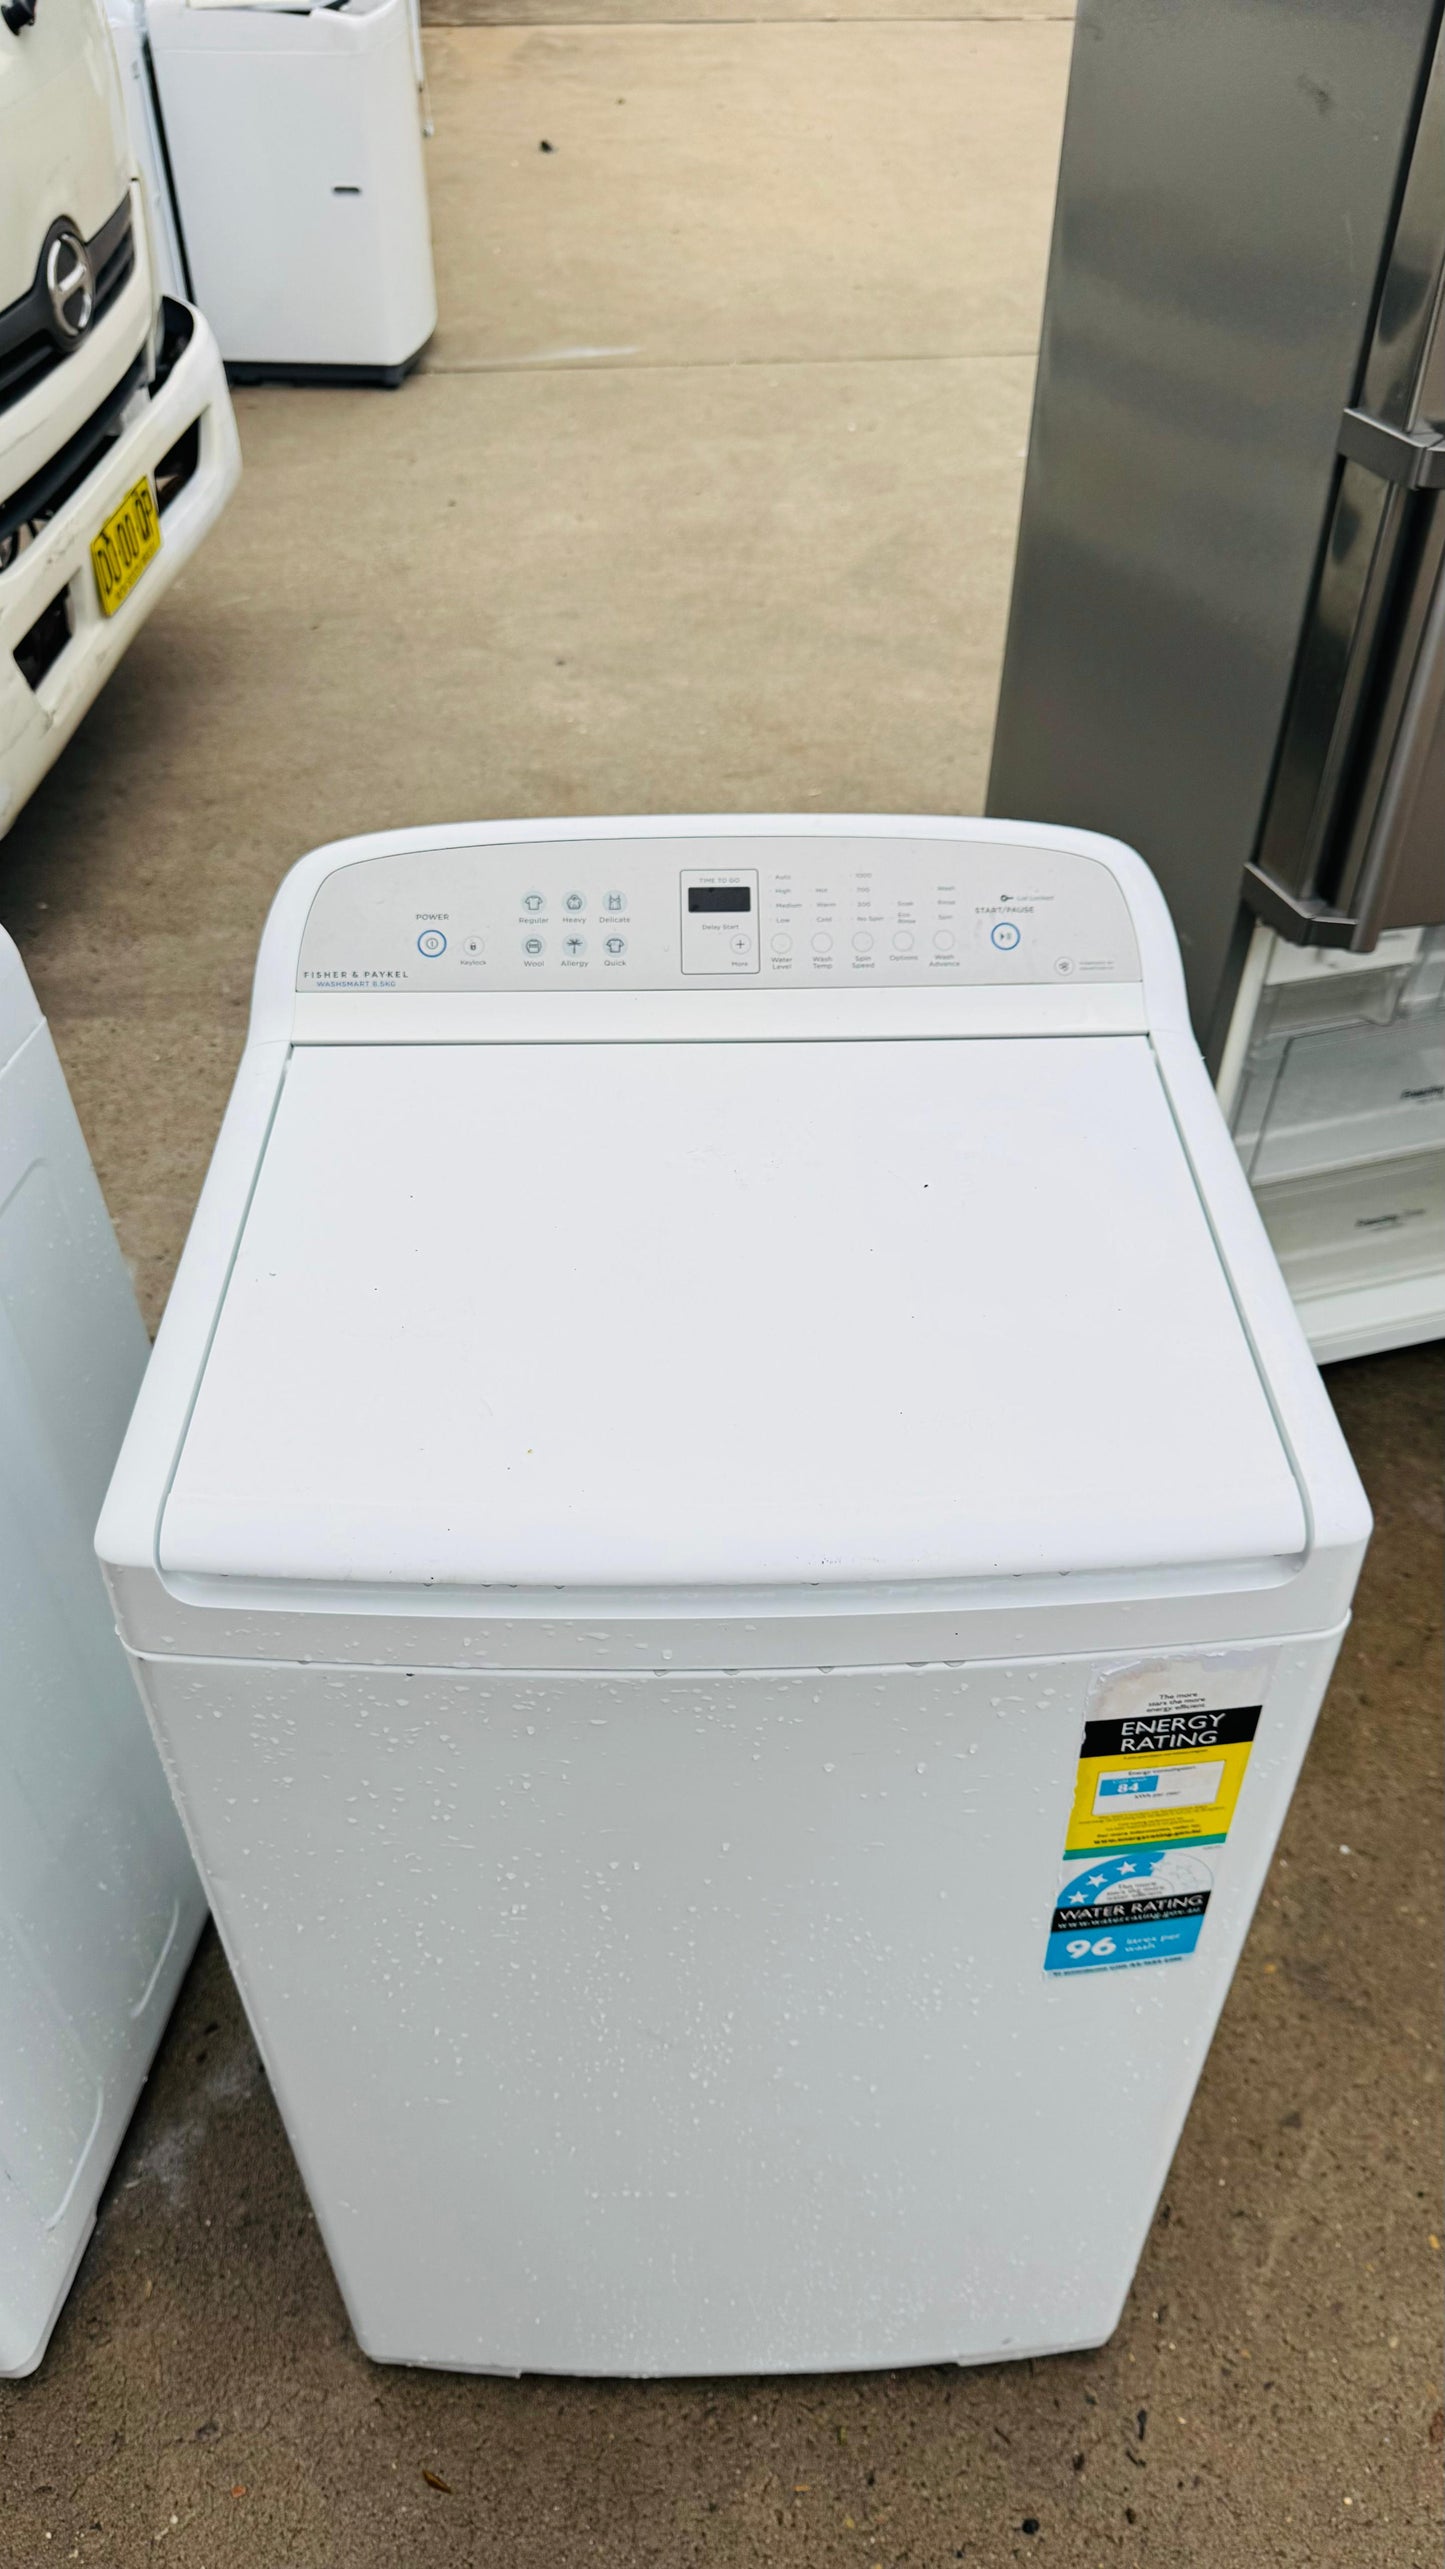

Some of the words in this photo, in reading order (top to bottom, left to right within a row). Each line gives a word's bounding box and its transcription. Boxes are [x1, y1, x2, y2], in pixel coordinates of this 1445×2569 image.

[975, 906, 1035, 914] START/PAUSE
[304, 971, 347, 979] FISHER
[1121, 1712, 1226, 1736] ENERGY
[1120, 1730, 1220, 1752] RATING
[1117, 1783, 1139, 1793] 84
[1060, 1904, 1125, 1921] WATER
[1131, 1895, 1204, 1914] RATING
[1160, 1934, 1180, 1942] per
[1066, 1936, 1116, 1959] 96
[1125, 1942, 1155, 1952] wash
